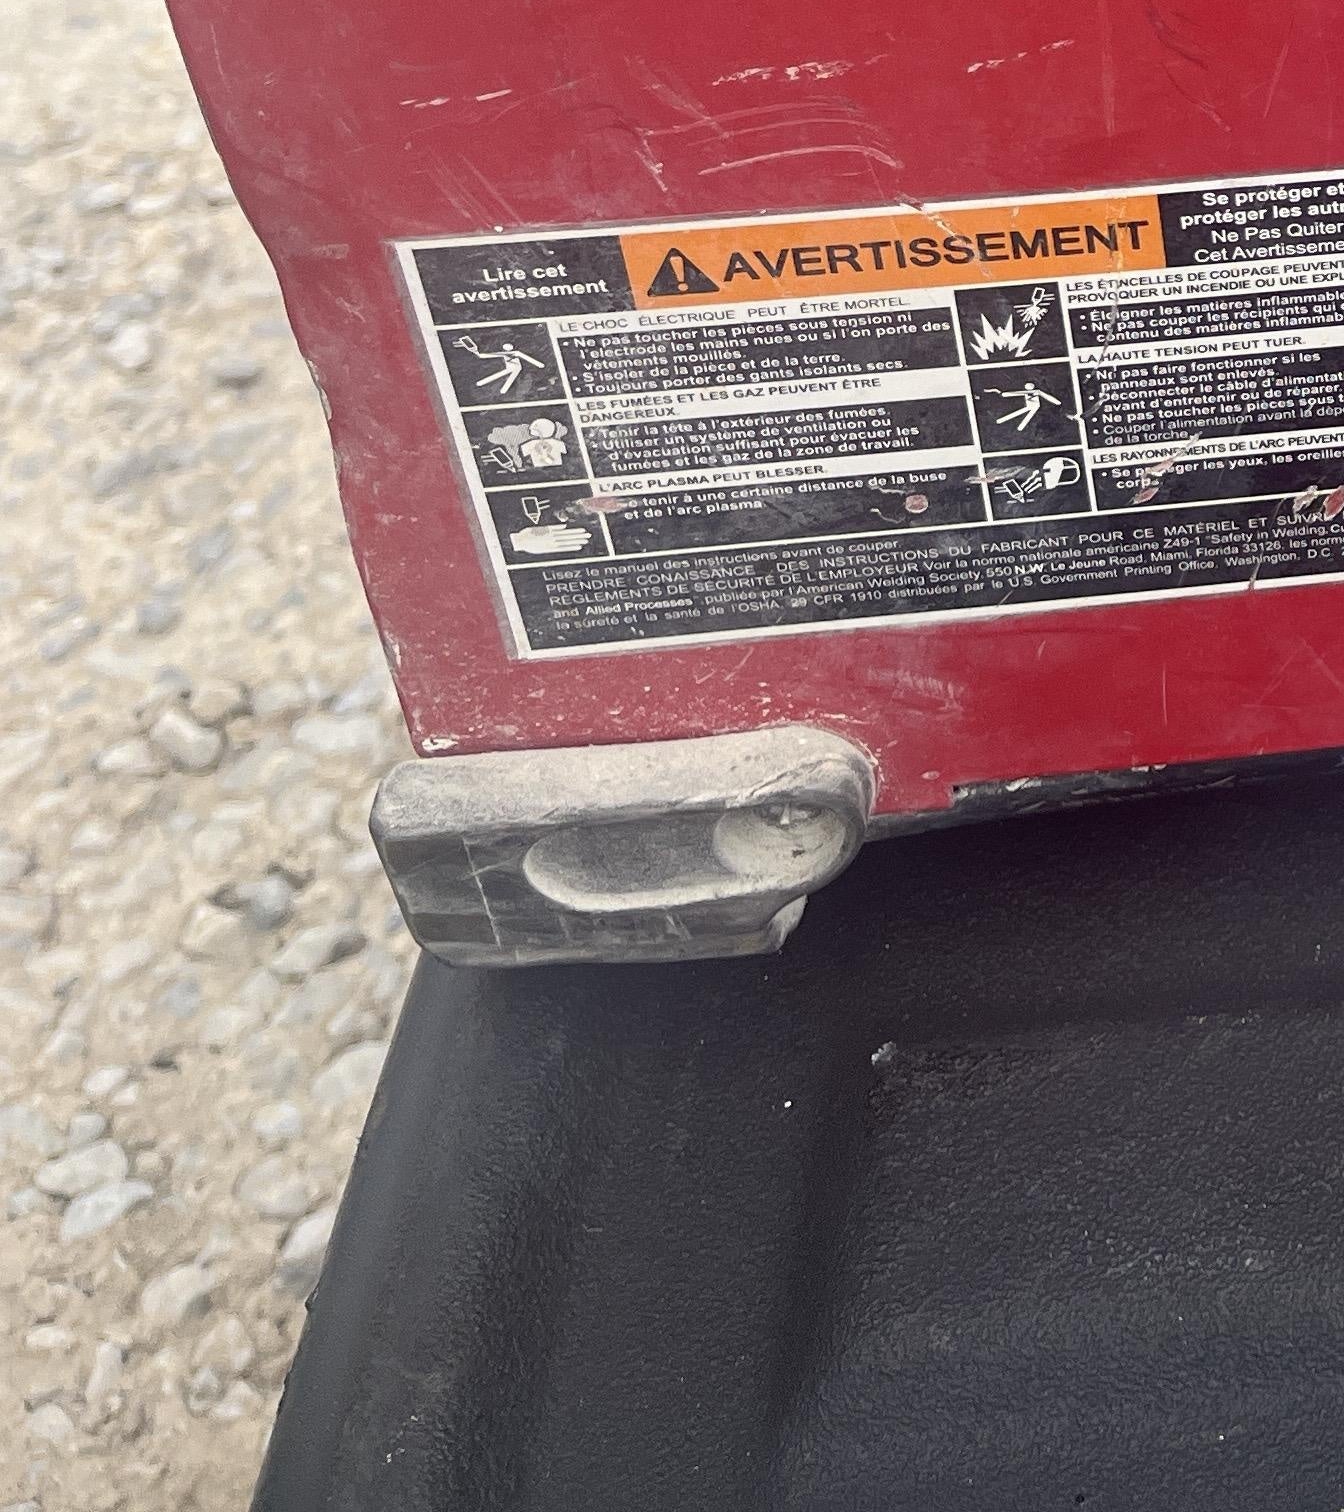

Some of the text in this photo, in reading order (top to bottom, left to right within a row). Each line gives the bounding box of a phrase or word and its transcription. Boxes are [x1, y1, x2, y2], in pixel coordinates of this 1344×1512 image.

[1201, 191, 1229, 206] Se
[1233, 183, 1322, 206] protéger
[1178, 206, 1268, 229] protéger
[1271, 203, 1302, 218] les
[1210, 219, 1344, 243] Ne Pas Quiter
[722, 220, 1149, 284] AVERTISSEMENT
[1192, 247, 1228, 263] Cet
[482, 262, 568, 284] Lire cet
[1065, 281, 1093, 291] LES
[1186, 271, 1207, 282] DE
[1208, 265, 1280, 279] COUPAGE
[451, 278, 609, 305] avertissement
[1066, 287, 1159, 303] PROVOQUER
[1161, 285, 1182, 296] UN
[1185, 279, 1251, 293] INCENDIE
[1254, 277, 1276, 288] OU
[1278, 274, 1308, 286] UNE
[557, 322, 579, 332] LE
[580, 318, 629, 330] CHOC
[637, 309, 736, 326] ÉLECTRIQUE
[746, 305, 788, 318] PEUT
[798, 299, 840, 313] ÊTRE
[572, 312, 912, 351] Ne pas toucher les pièces sous tension ni
[1095, 326, 1159, 342] contenu
[1162, 324, 1192, 336] des
[1195, 319, 1261, 333] matières
[1077, 336, 1305, 364] LA HAUTE TENSION PEUT TUER.
[1099, 365, 1279, 393] panneaux sont enlevés.
[574, 376, 881, 412] LES FUMÉES ET LES GAZ PEUVENT ÊTRE
[1101, 412, 1122, 423] Ne
[1126, 411, 1154, 423] pas
[1157, 404, 1216, 418] toucher
[1219, 402, 1242, 413] les
[1245, 397, 1295, 412] pièces
[1298, 393, 1335, 408] sous
[597, 404, 891, 439] Tenir la tête à l'extérieur des fumées.
[1092, 453, 1117, 464] LES
[1228, 441, 1246, 451] DE
[1249, 438, 1285, 450] L'ARC
[1287, 432, 1344, 446] PEUVENT
[597, 480, 643, 493] L'ARC
[646, 474, 710, 488] PLASMA
[711, 471, 752, 482] PEUT
[641, 470, 946, 506] tenir à une certaine distance de la buse
